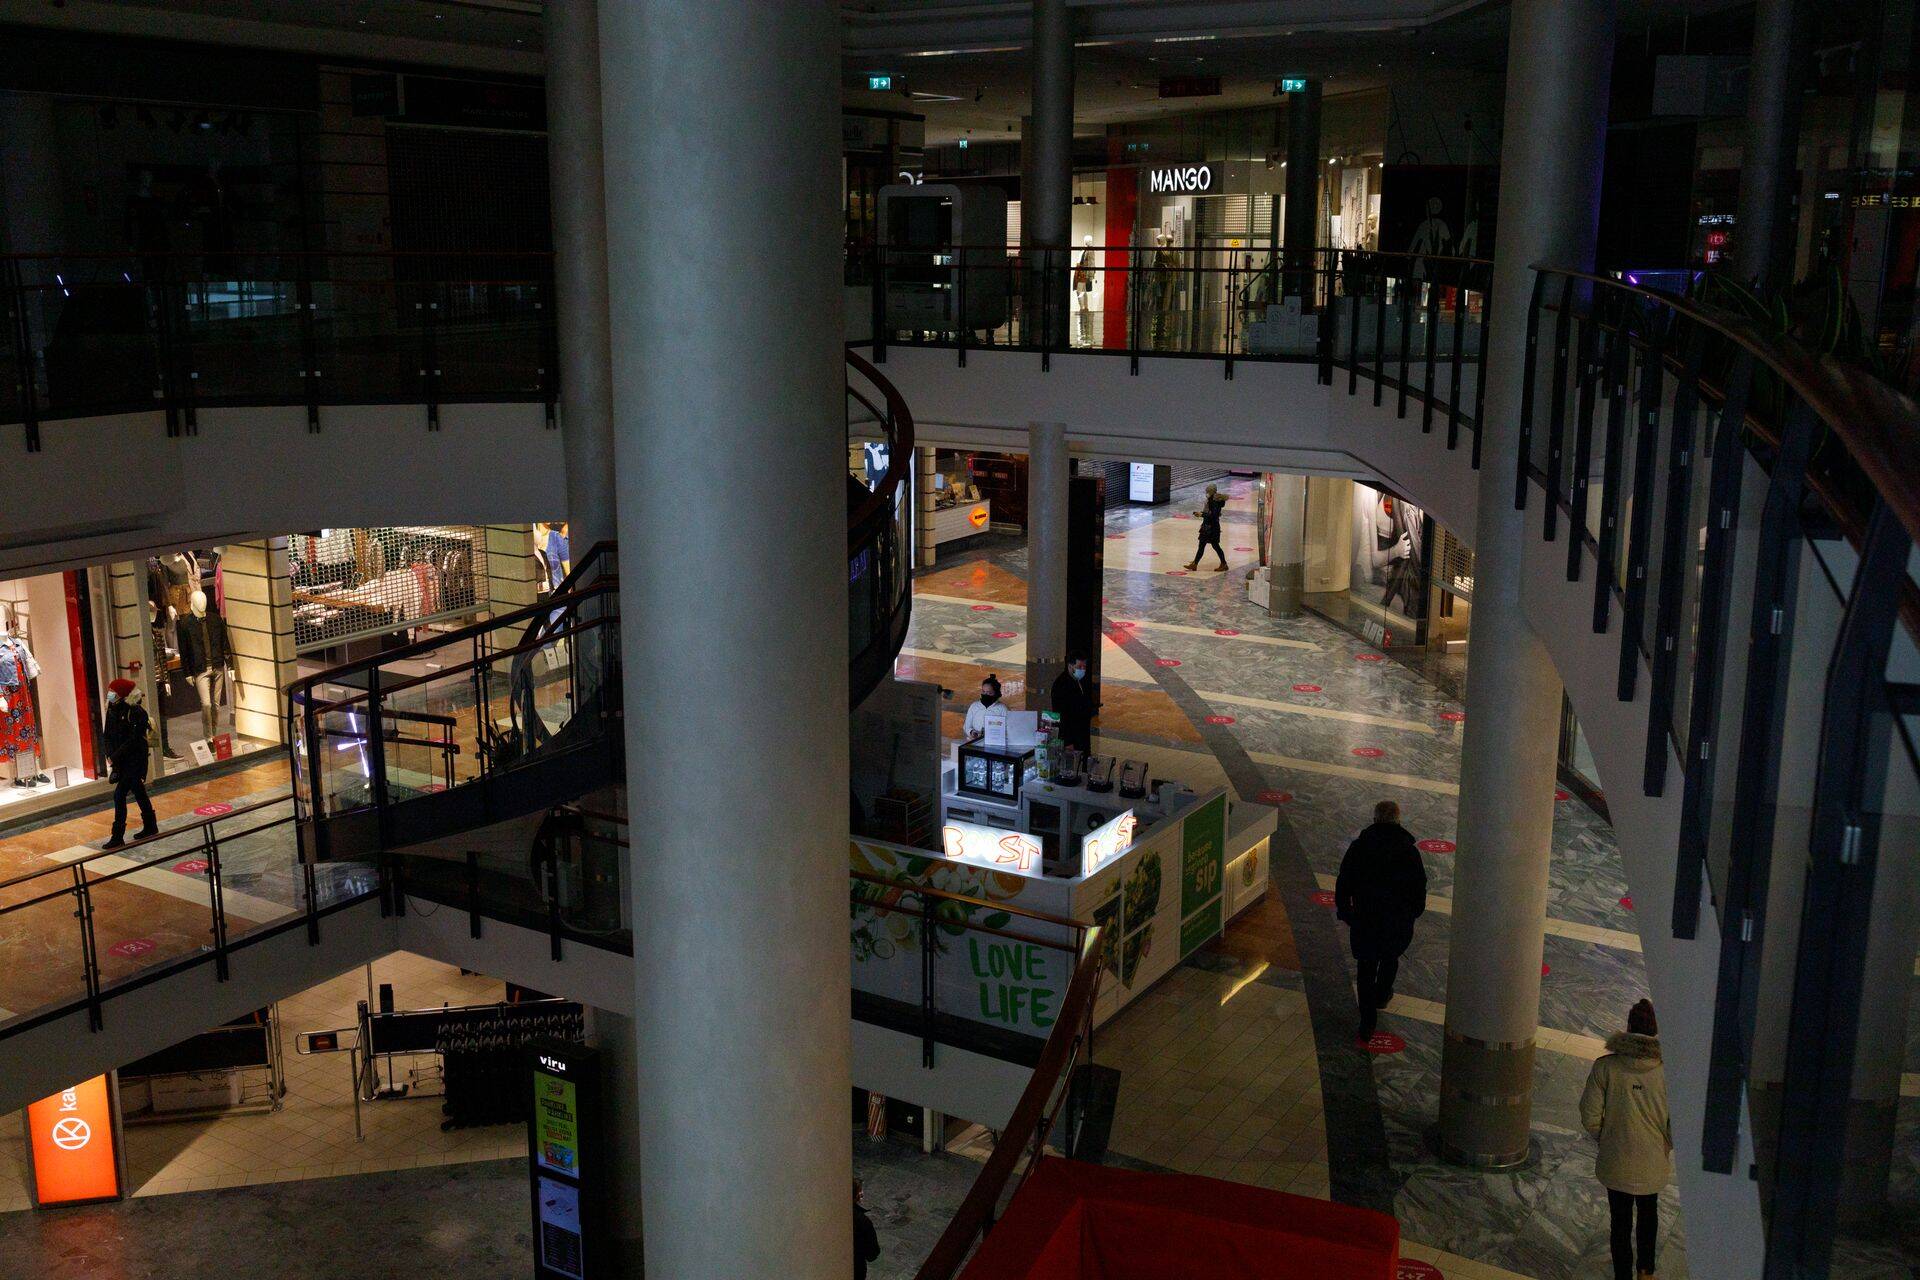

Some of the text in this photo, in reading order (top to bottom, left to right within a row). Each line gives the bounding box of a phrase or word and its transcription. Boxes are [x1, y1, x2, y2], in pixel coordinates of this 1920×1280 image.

[1150, 165, 1211, 193] MANGO
[943, 826, 1040, 870] BST
[1086, 815, 1137, 874] BST
[969, 937, 1047, 981] LOVE
[979, 982, 1056, 1028] LIFE
[540, 1055, 566, 1071] viru
